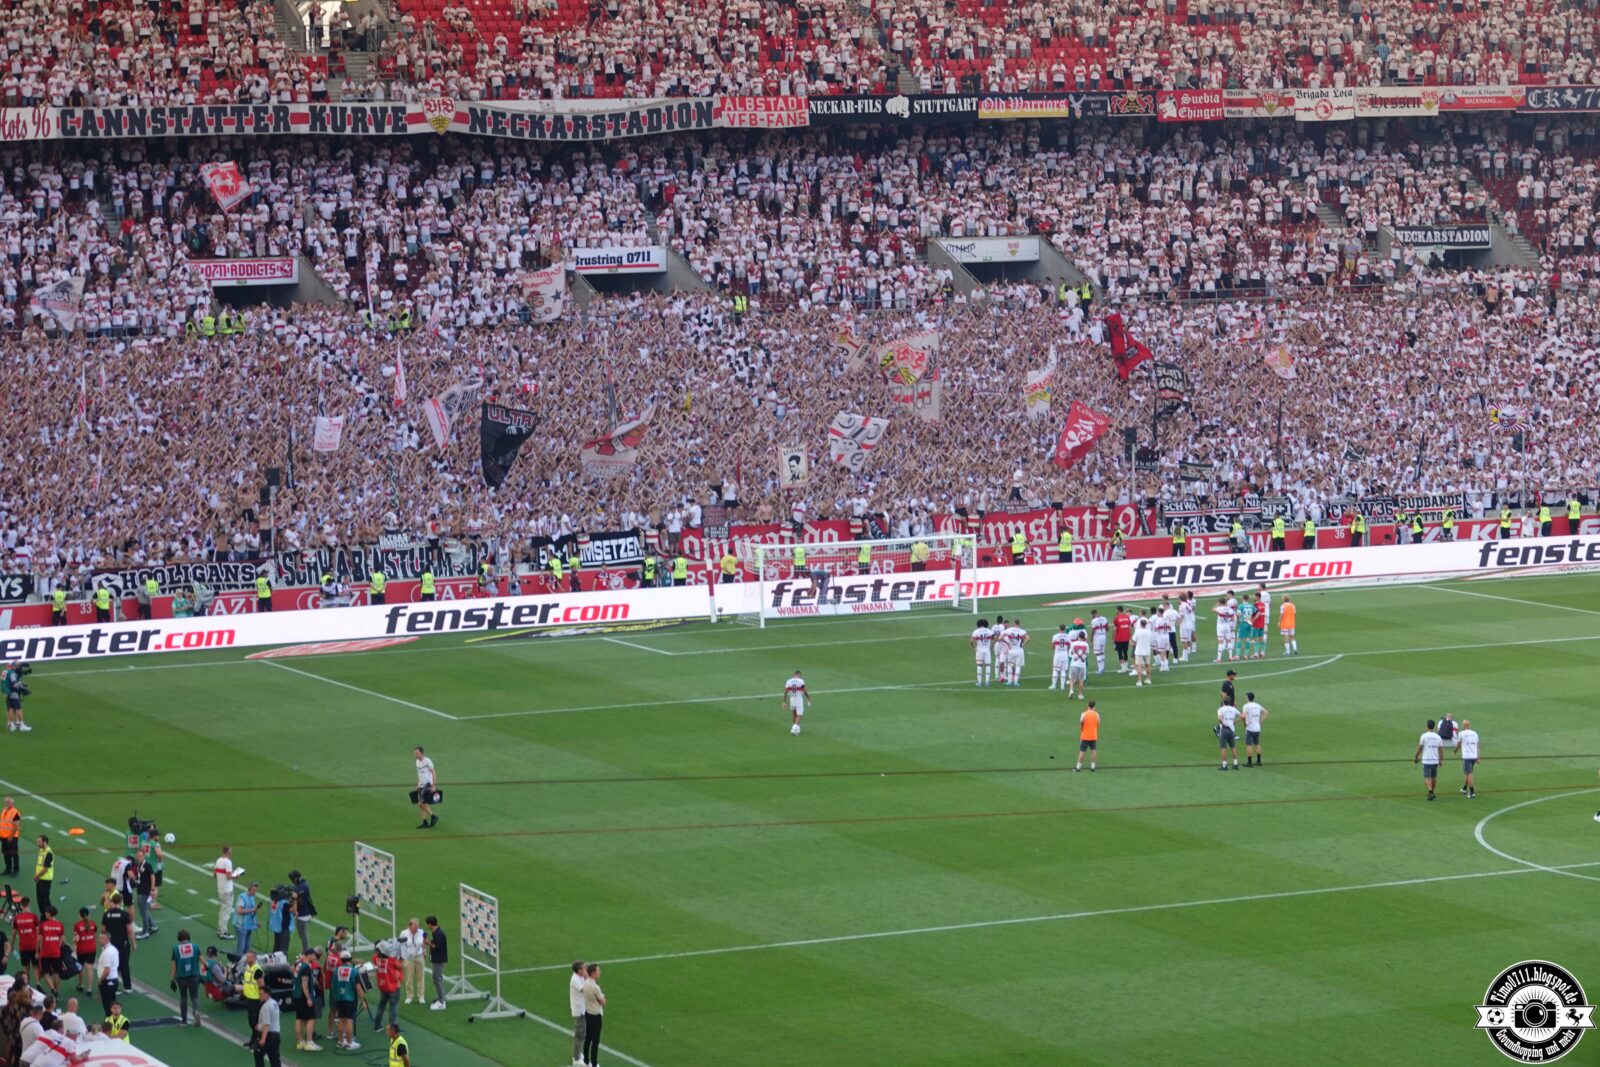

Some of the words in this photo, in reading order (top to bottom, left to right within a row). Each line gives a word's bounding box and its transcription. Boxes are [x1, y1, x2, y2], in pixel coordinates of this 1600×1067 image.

[1295, 89, 1329, 100] Brigada
[1332, 89, 1353, 98] Loca
[723, 96, 808, 112] ALBSTADT
[809, 99, 882, 115] NECKAR-FILS
[913, 97, 979, 115] STUTTGART
[982, 97, 1006, 113] Old
[1008, 96, 1067, 113] Warriors
[32, 105, 51, 139] 96
[60, 106, 290, 138] CANNSTATTER
[308, 105, 407, 136] KURVE
[468, 102, 713, 141] NECKARSTADION
[726, 113, 806, 127] VFB-FANS
[1396, 227, 1490, 245] NECKARSTADION
[626, 250, 651, 264] 0711
[204, 264, 227, 278] 0711
[231, 263, 277, 277] ADDICTS
[1335, 530, 1345, 540] 36
[1133, 559, 1353, 590] fenster.com
[81, 604, 92, 614] 33
[385, 601, 628, 634] fenster.com
[0, 629, 235, 661] enster.com
